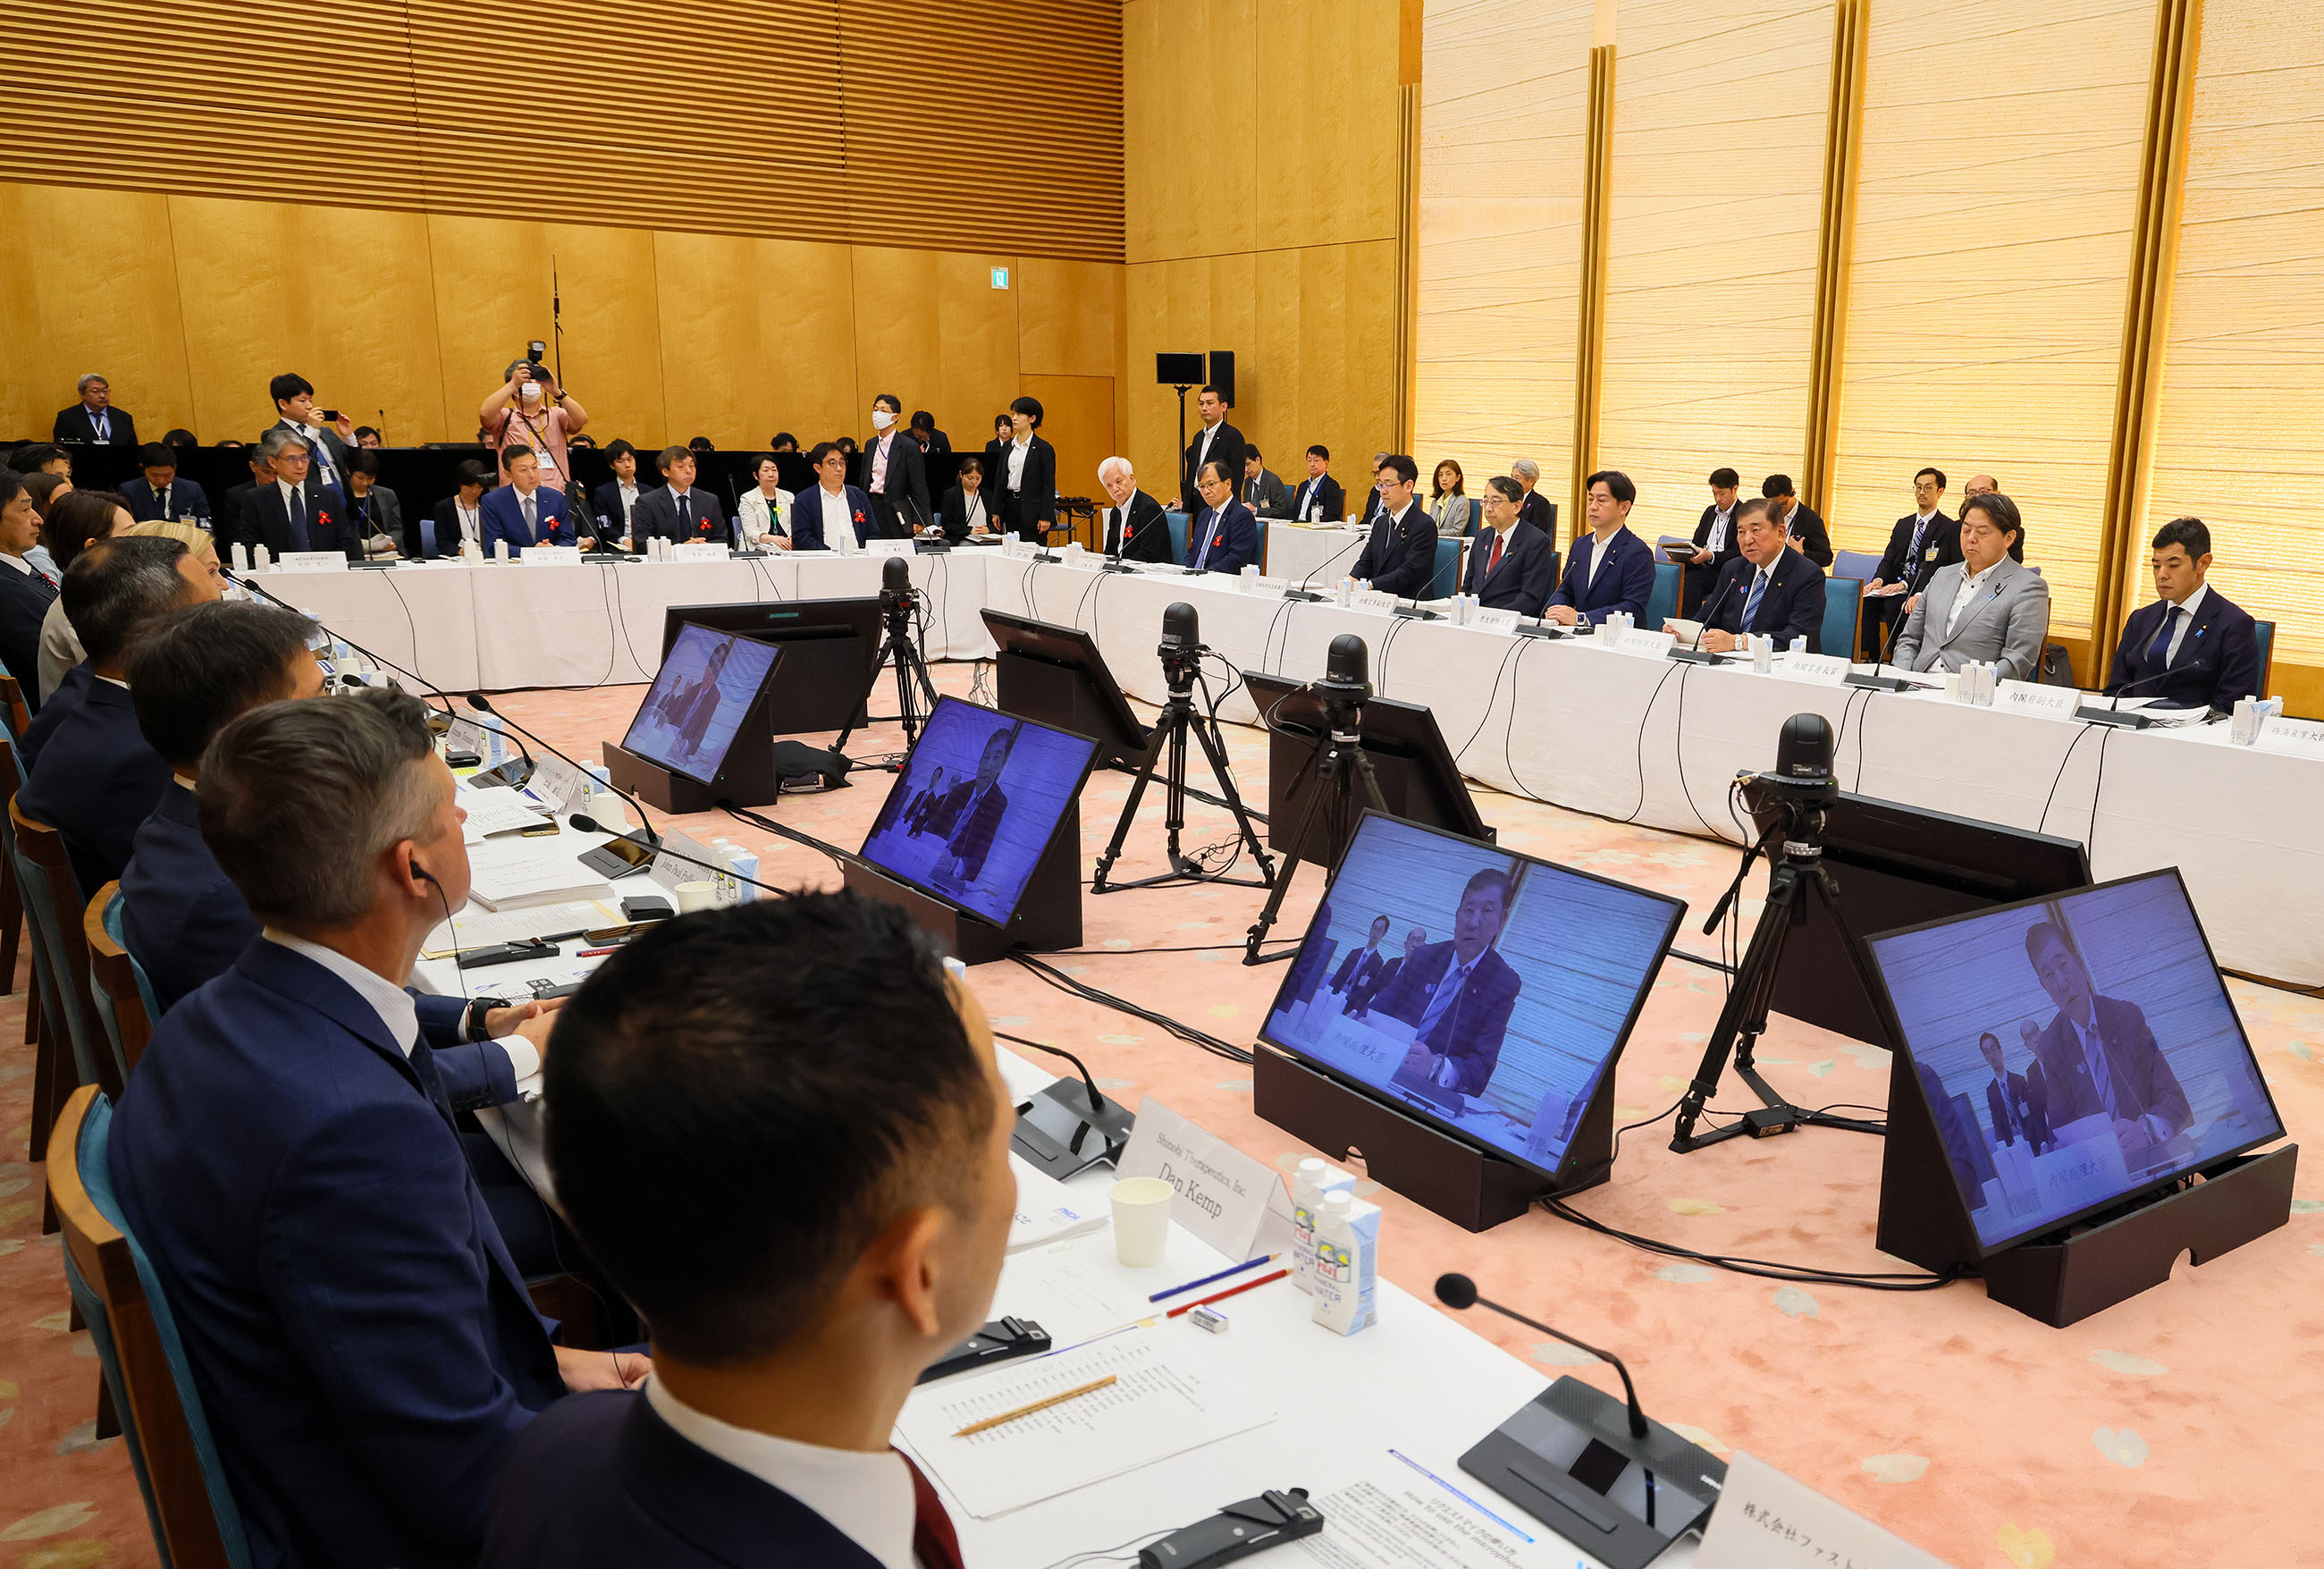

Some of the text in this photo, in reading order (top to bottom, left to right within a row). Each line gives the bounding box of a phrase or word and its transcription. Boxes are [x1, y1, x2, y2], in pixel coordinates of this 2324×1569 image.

[2008, 692, 2064, 708] 内閣府副大臣
[1157, 1132, 1183, 1157] Shinobi
[1158, 1162, 1223, 1219] Dan Kemp
[1402, 1489, 1423, 1505] How
[1436, 1508, 1453, 1523] use
[1452, 1519, 1469, 1537] the
[1744, 1501, 1866, 1569] 株式会社ファスト
